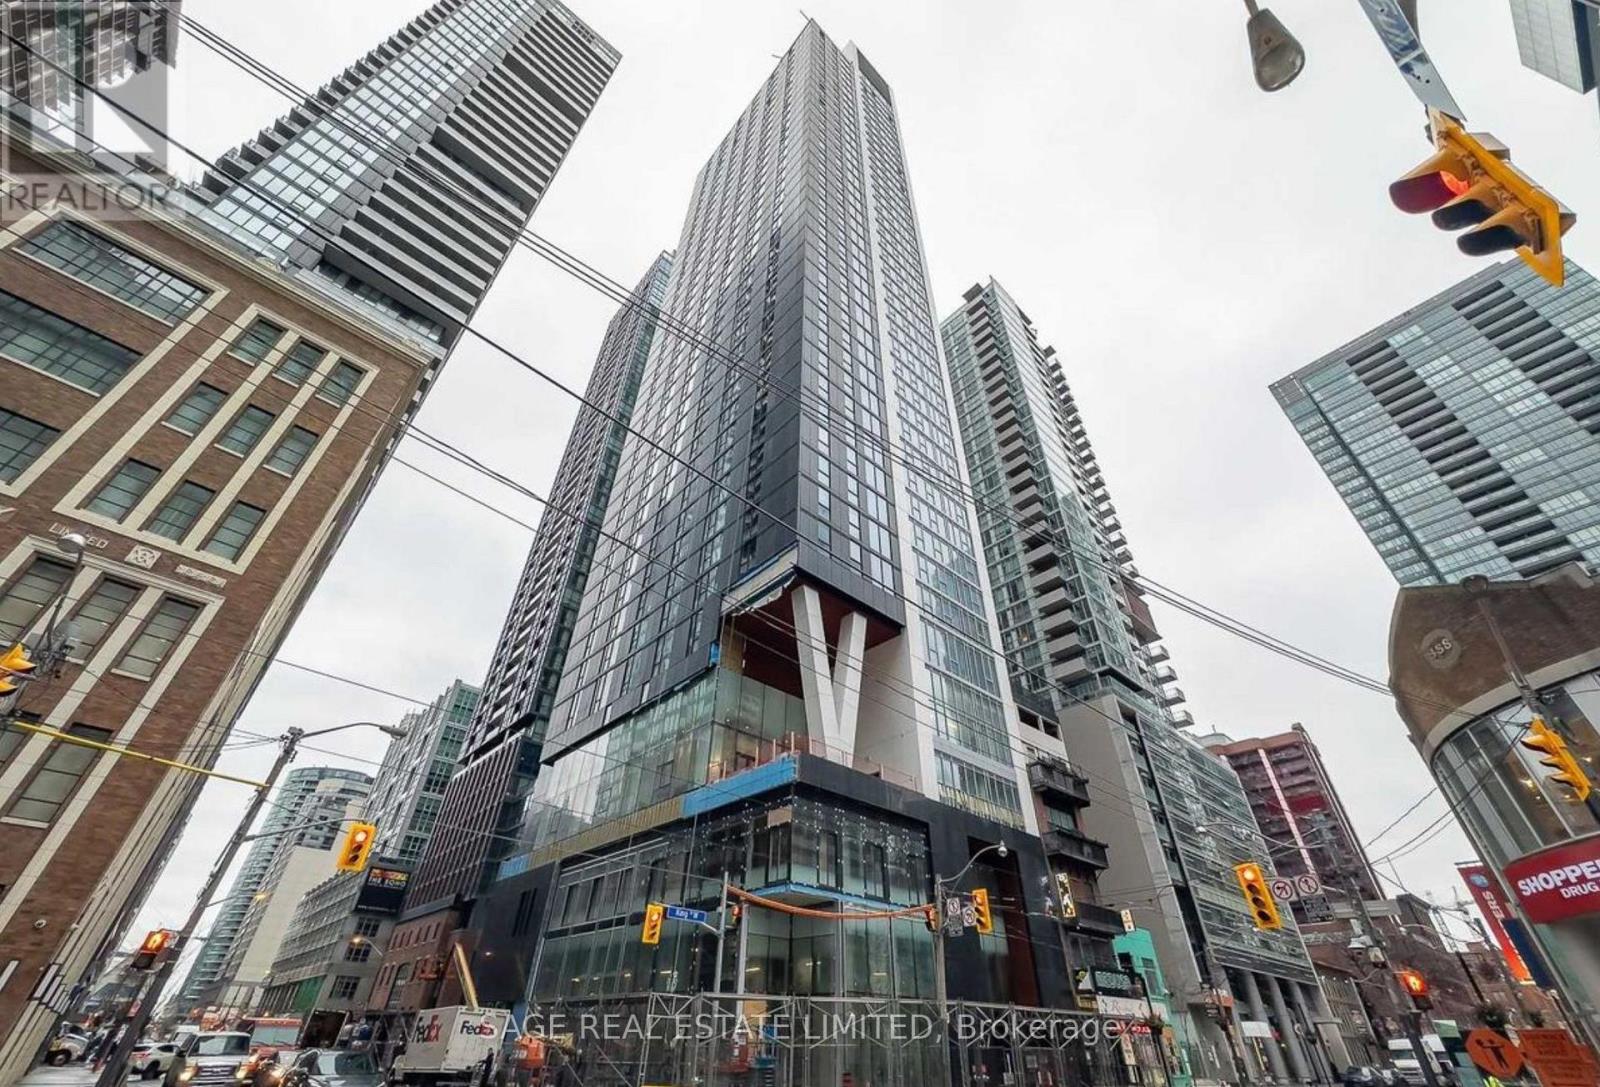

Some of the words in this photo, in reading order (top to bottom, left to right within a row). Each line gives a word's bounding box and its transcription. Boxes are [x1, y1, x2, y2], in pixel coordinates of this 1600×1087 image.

[1517, 858, 1600, 897] SHOPPE
[1560, 881, 1599, 899] DRUG
[460, 1020, 495, 1036] FedEx
